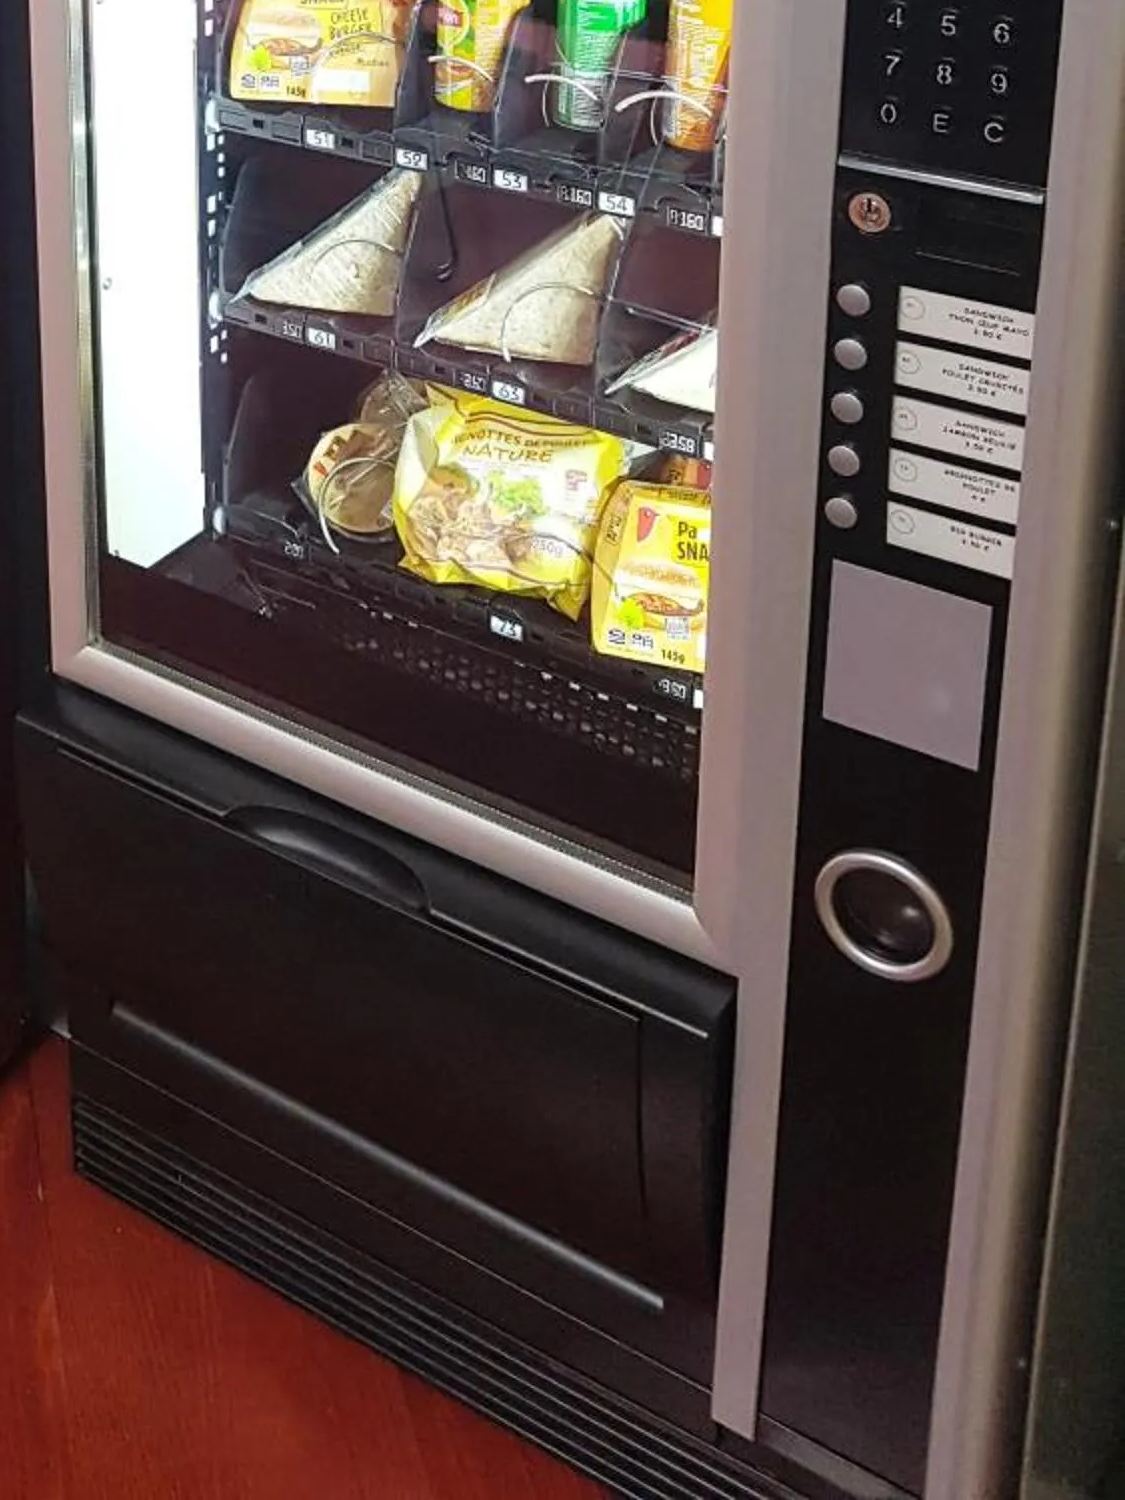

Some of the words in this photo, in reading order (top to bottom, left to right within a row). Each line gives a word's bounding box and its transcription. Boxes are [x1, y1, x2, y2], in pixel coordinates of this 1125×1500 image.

[887, 6, 903, 29] 4
[941, 15, 957, 36] 5
[993, 23, 1010, 45] 6
[885, 56, 901, 77] 7
[936, 64, 953, 86] 8
[990, 72, 1008, 94] 9
[880, 104, 897, 125] 0
[933, 112, 950, 134] E
[984, 121, 1004, 144] C
[401, 151, 422, 167] 52
[502, 170, 523, 189] 53
[606, 192, 629, 212] 54
[314, 329, 331, 345] 61
[499, 382, 520, 400] 63
[463, 443, 554, 463] NATURE
